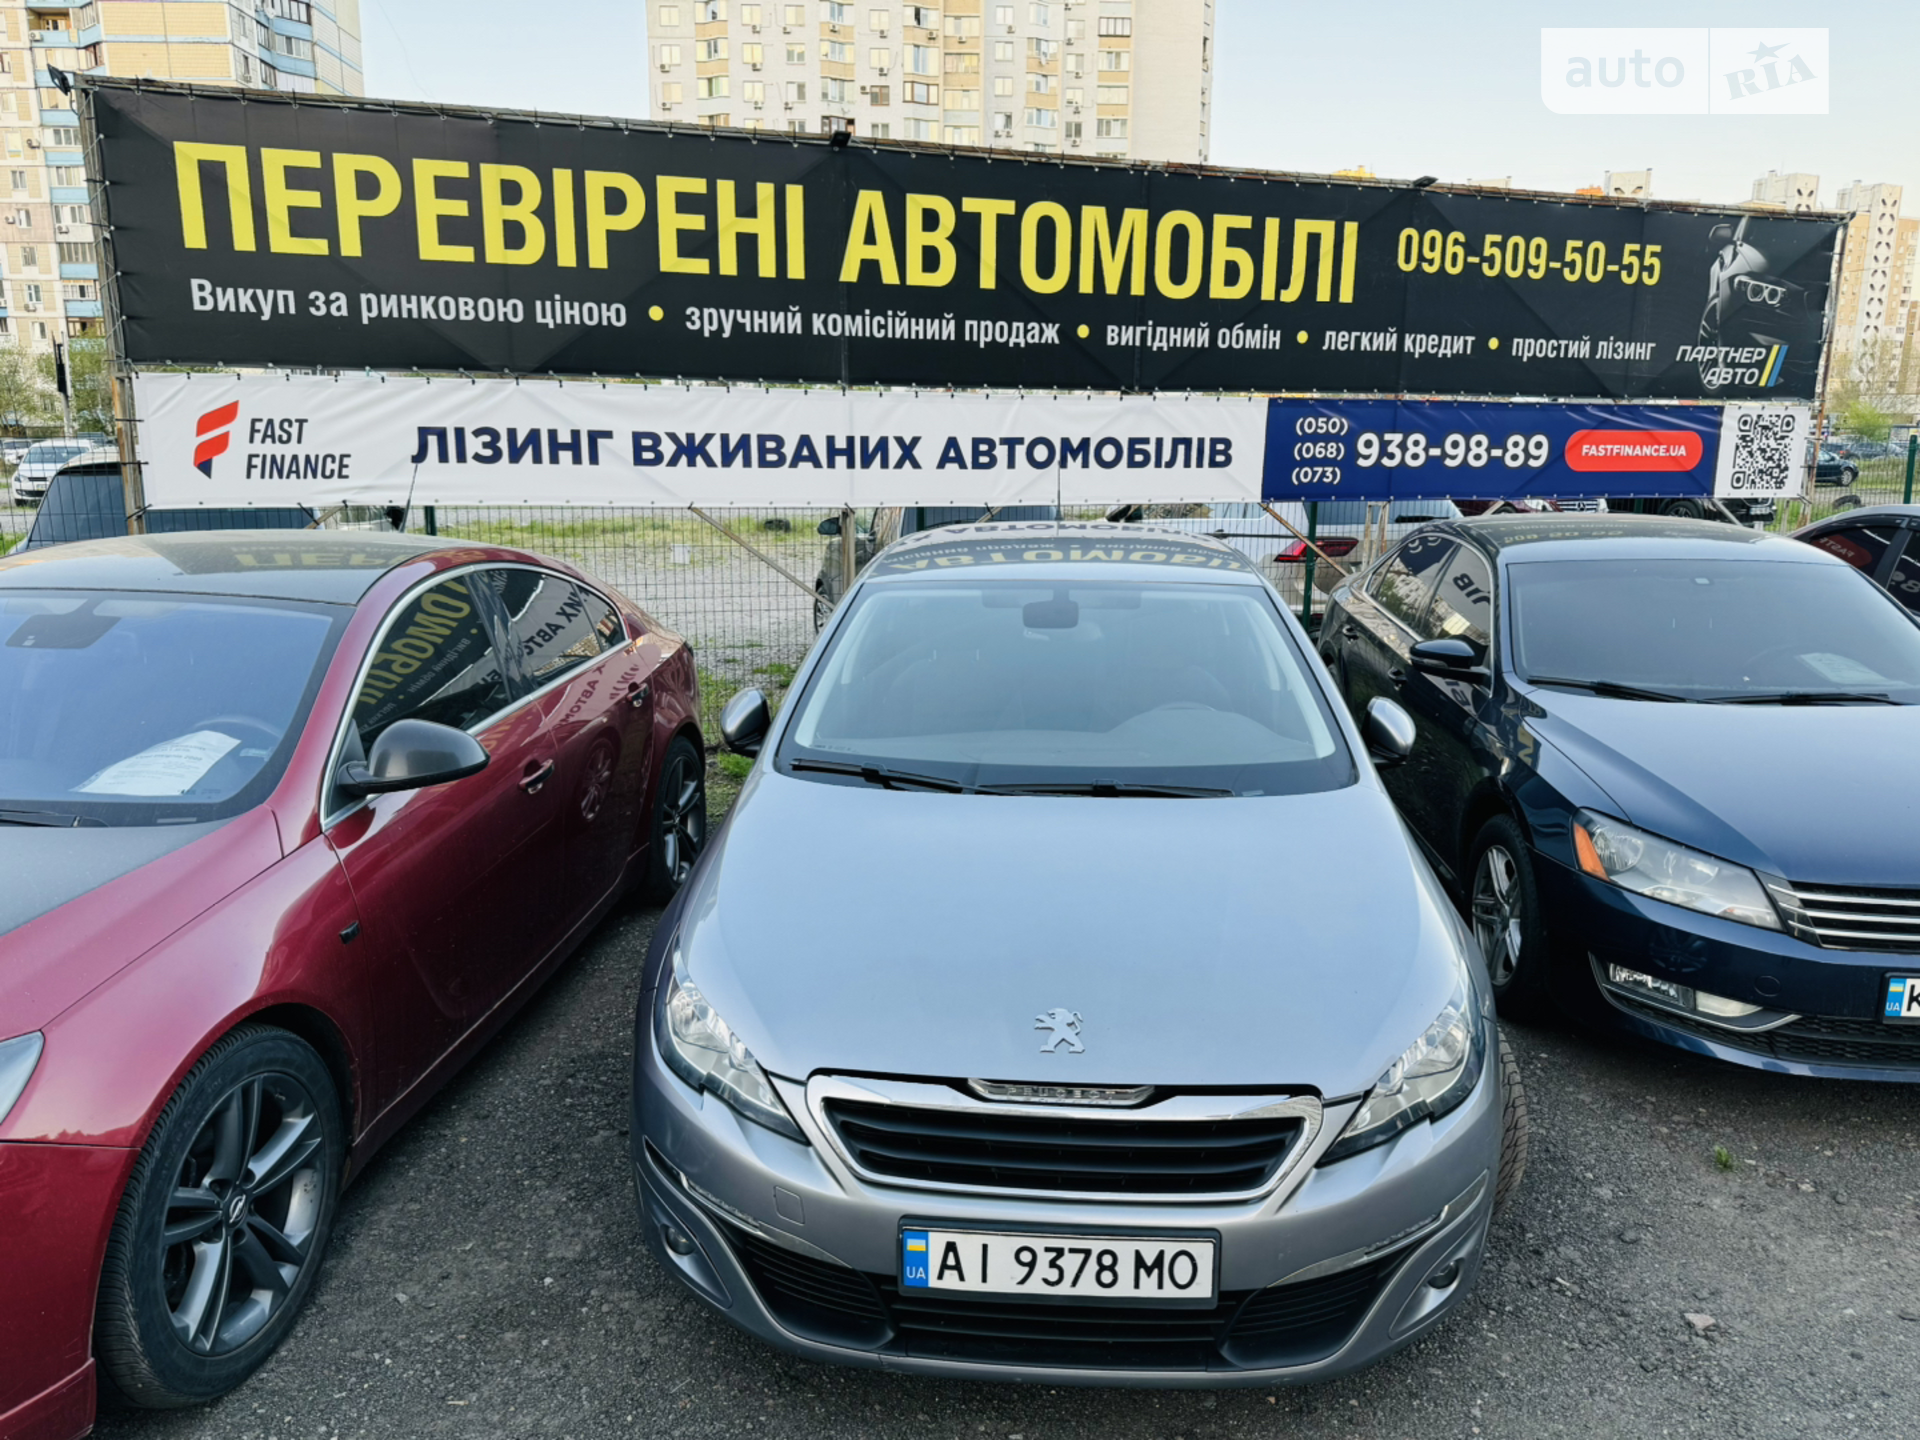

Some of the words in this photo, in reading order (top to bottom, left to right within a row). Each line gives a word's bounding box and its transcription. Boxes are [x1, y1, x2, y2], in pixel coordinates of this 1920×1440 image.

[172, 141, 806, 282] ПЕРЕВІРЕНІ
[839, 188, 1359, 304] АВТОМОБІЛІ
[1398, 227, 1663, 287] 096-509-50-55
[190, 279, 296, 321] Викуп
[308, 290, 349, 317] за
[359, 291, 524, 325] ринковою
[535, 293, 627, 329] ціною
[685, 305, 802, 338] зручний
[812, 309, 956, 342] комісійний
[964, 319, 1061, 349] продаж
[1106, 322, 1210, 352] вигідний
[1217, 323, 1281, 350] обмін
[1322, 328, 1398, 352] легкий
[1404, 333, 1476, 359] кредит
[1511, 335, 1591, 362] простий
[1595, 340, 1657, 361] лізинг
[1676, 345, 1767, 363] ПАРТНЕР
[1704, 367, 1760, 385] АВТО
[248, 418, 309, 445] FAST
[1295, 417, 1349, 436] (050)
[410, 426, 614, 466] ЛІЗИНГ
[631, 431, 922, 470] ВЖИВАНИХ
[935, 436, 1233, 470] АВТОМОБІЛІВ
[1293, 442, 1345, 461] (068)
[1356, 432, 1549, 468] 938-98-89
[1581, 444, 1687, 458] FASTFINANCE.UA
[246, 453, 352, 480] FINANCE
[1291, 466, 1341, 486] (073)
[1886, 1002, 1900, 1011] UA
[906, 1266, 926, 1279] UA
[936, 1241, 989, 1284] AI
[1014, 1245, 1120, 1290] 9378
[1133, 1249, 1199, 1290] MO
